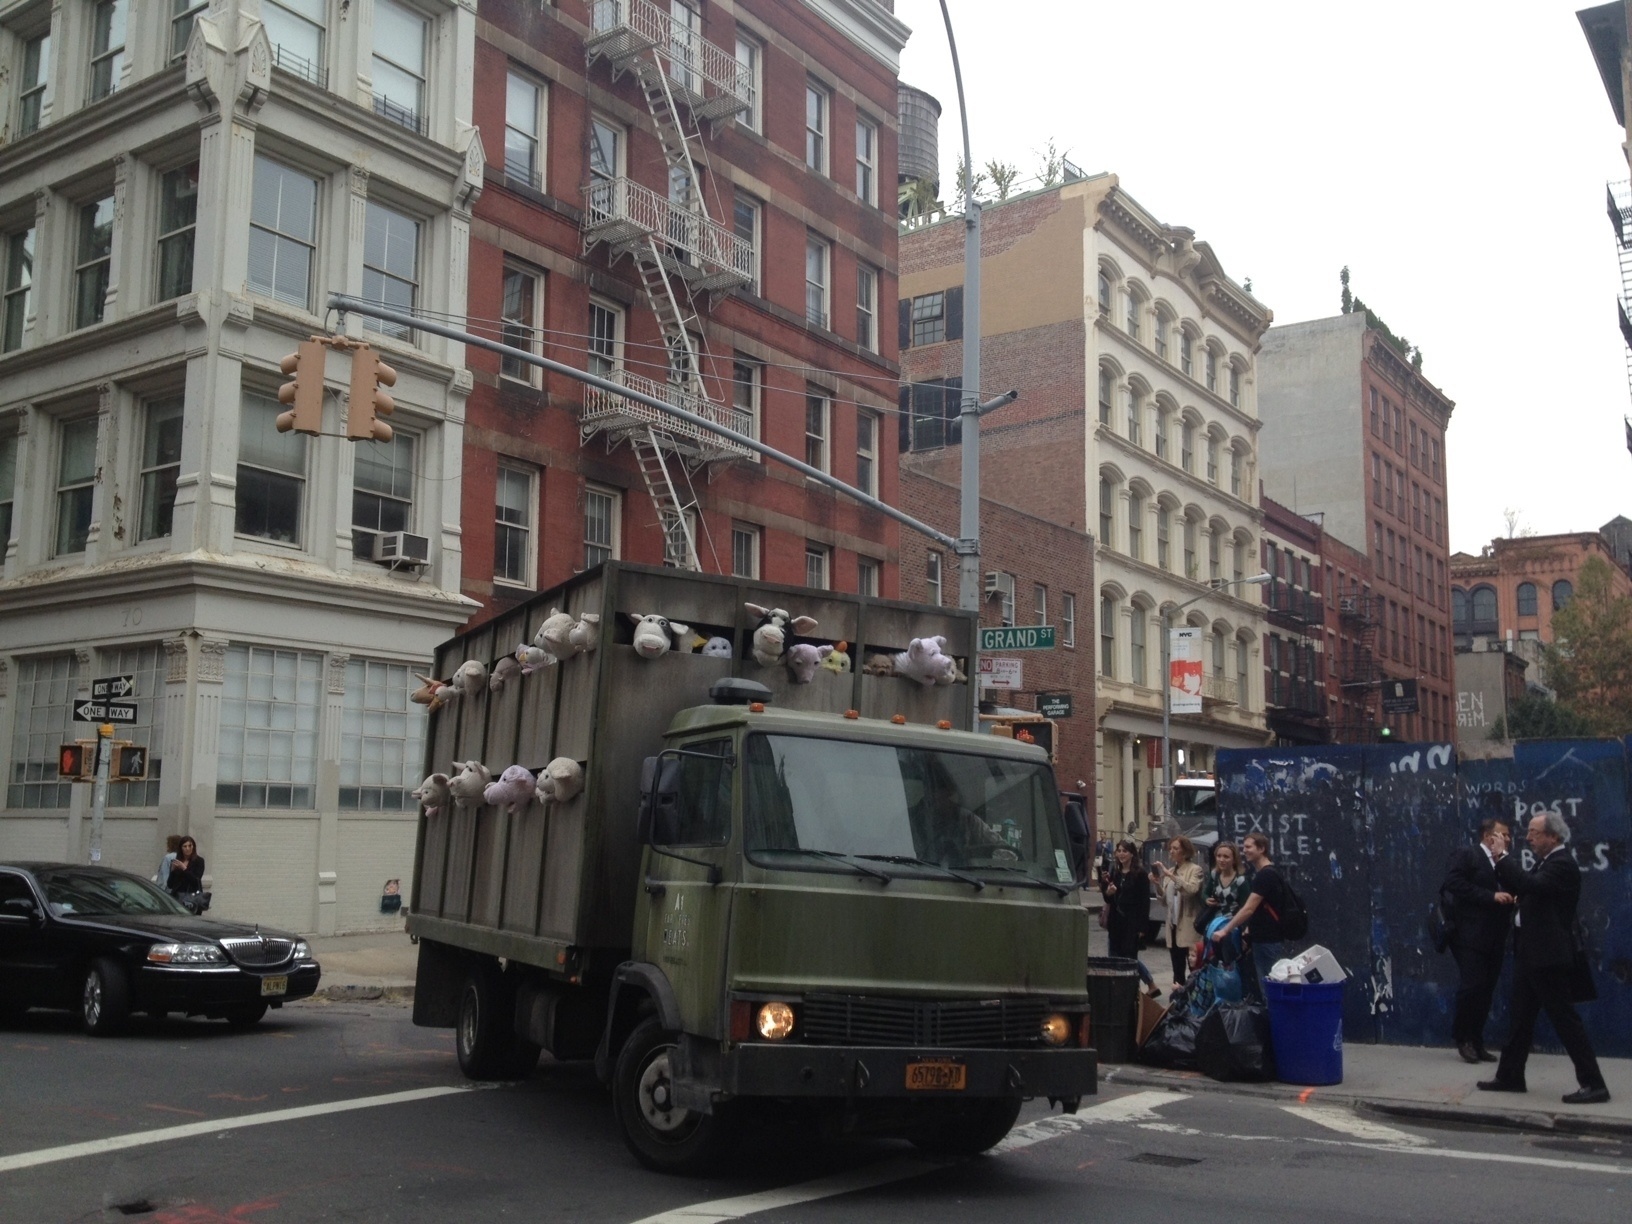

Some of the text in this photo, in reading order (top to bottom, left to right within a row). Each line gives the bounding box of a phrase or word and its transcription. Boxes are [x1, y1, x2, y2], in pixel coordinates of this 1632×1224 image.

[984, 629, 1052, 648] GRAND ST
[981, 660, 992, 671] NO
[114, 681, 127, 691] WAY
[83, 706, 130, 718] ONE WAY
[1514, 797, 1583, 822] POST
[1234, 813, 1309, 833] EXIST
[1234, 835, 1323, 856] EILE:
[1520, 842, 1611, 873] BLS
